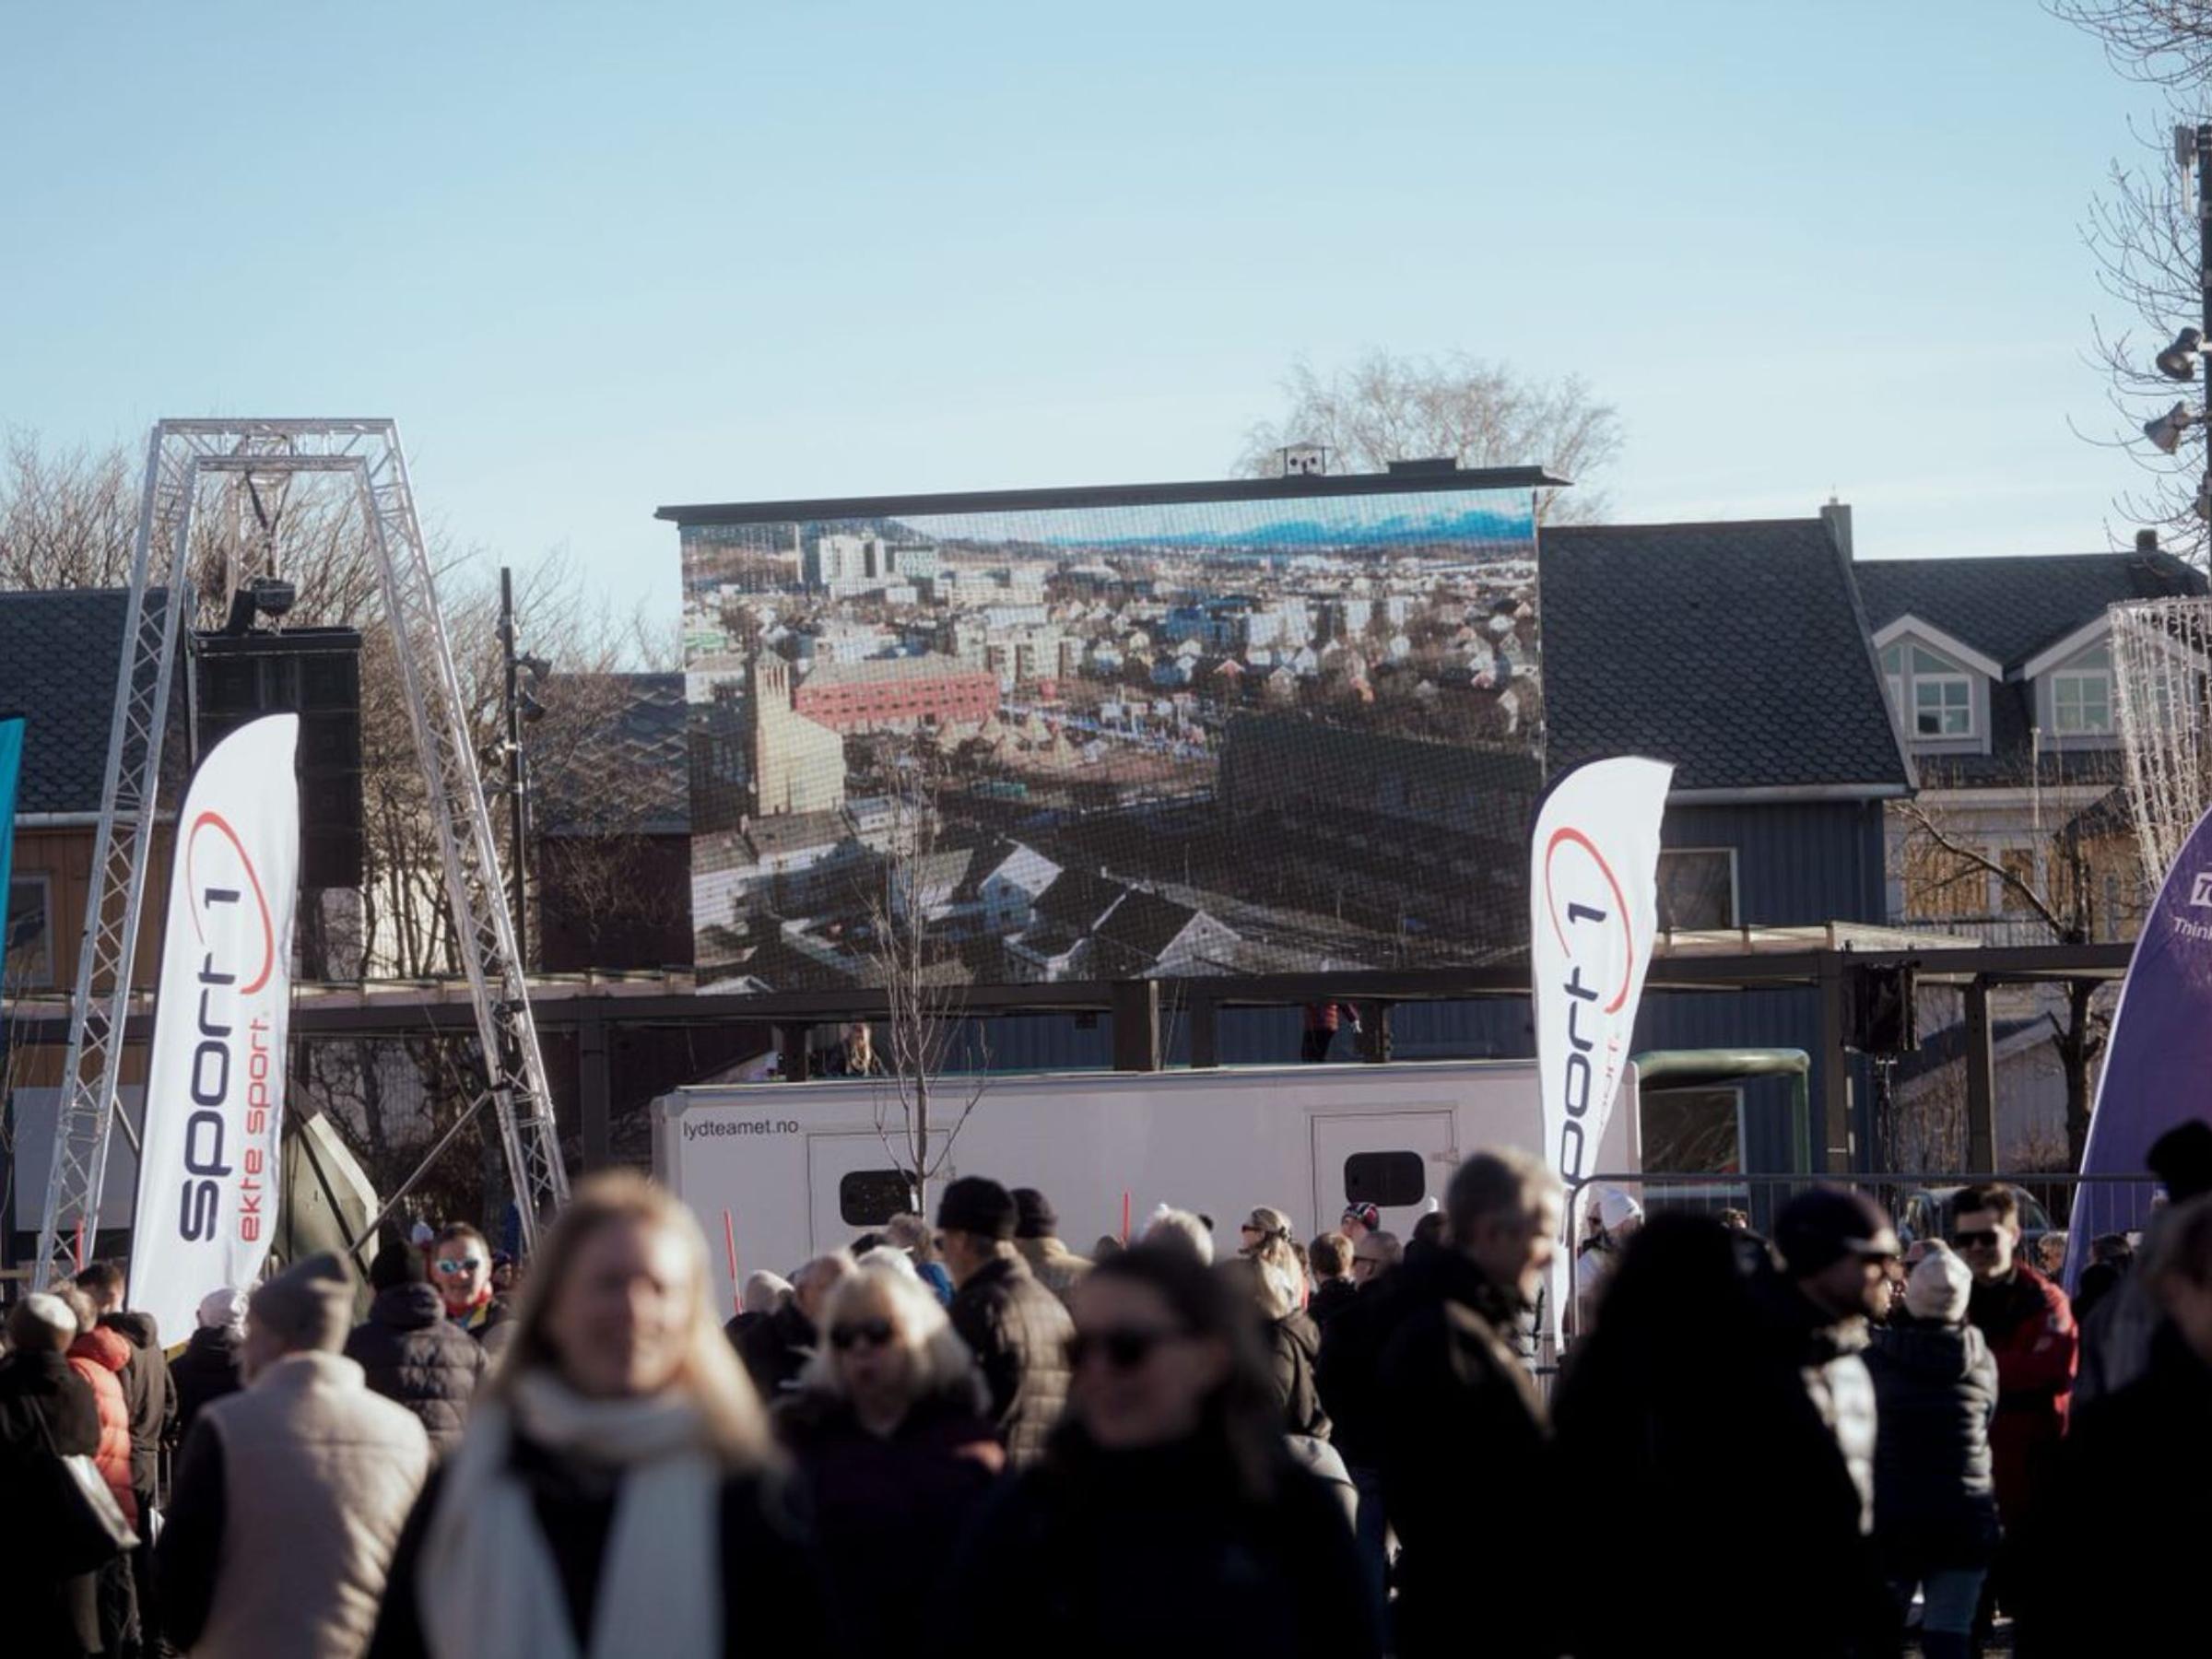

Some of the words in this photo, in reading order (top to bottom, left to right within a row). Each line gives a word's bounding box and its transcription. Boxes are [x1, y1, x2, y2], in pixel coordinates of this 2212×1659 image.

[204, 888, 241, 910] 1
[1567, 901, 1607, 924] 1
[2174, 915, 2212, 940] Thin
[179, 951, 236, 1242] sport
[245, 1018, 270, 1135] sport
[1559, 965, 1600, 1194] port
[683, 1119, 799, 1141] lydteamet.no
[238, 1147, 264, 1243] ekte
